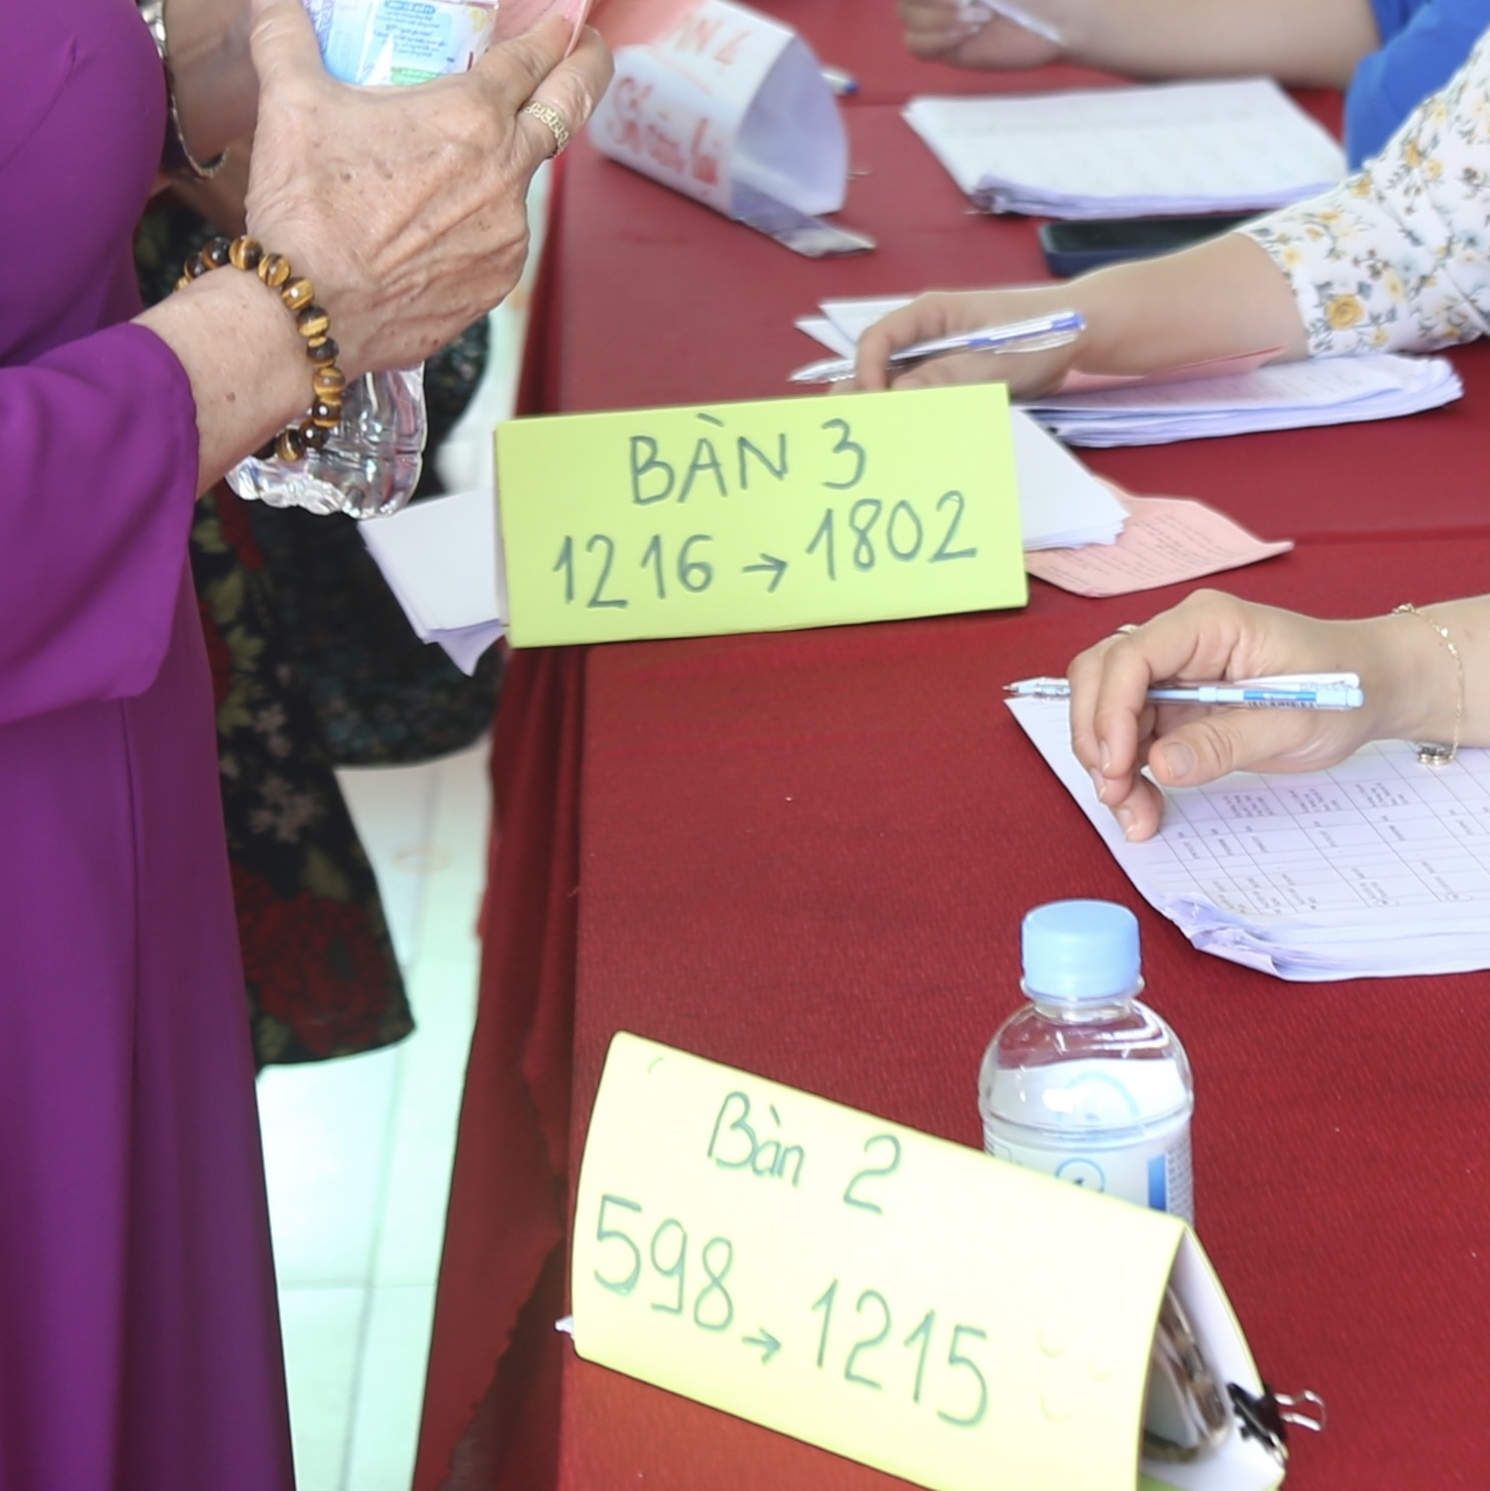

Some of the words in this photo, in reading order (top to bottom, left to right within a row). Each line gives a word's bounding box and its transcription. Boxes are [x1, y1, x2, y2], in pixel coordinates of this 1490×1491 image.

[629, 413, 789, 506] BÀN
[820, 418, 866, 489] 3
[552, 534, 715, 609] 1216
[805, 491, 977, 582] 1802
[706, 1090, 805, 1187] Bàn
[842, 1133, 902, 1214] 2
[593, 1194, 736, 1332] 598
[811, 1278, 989, 1428] 1215
